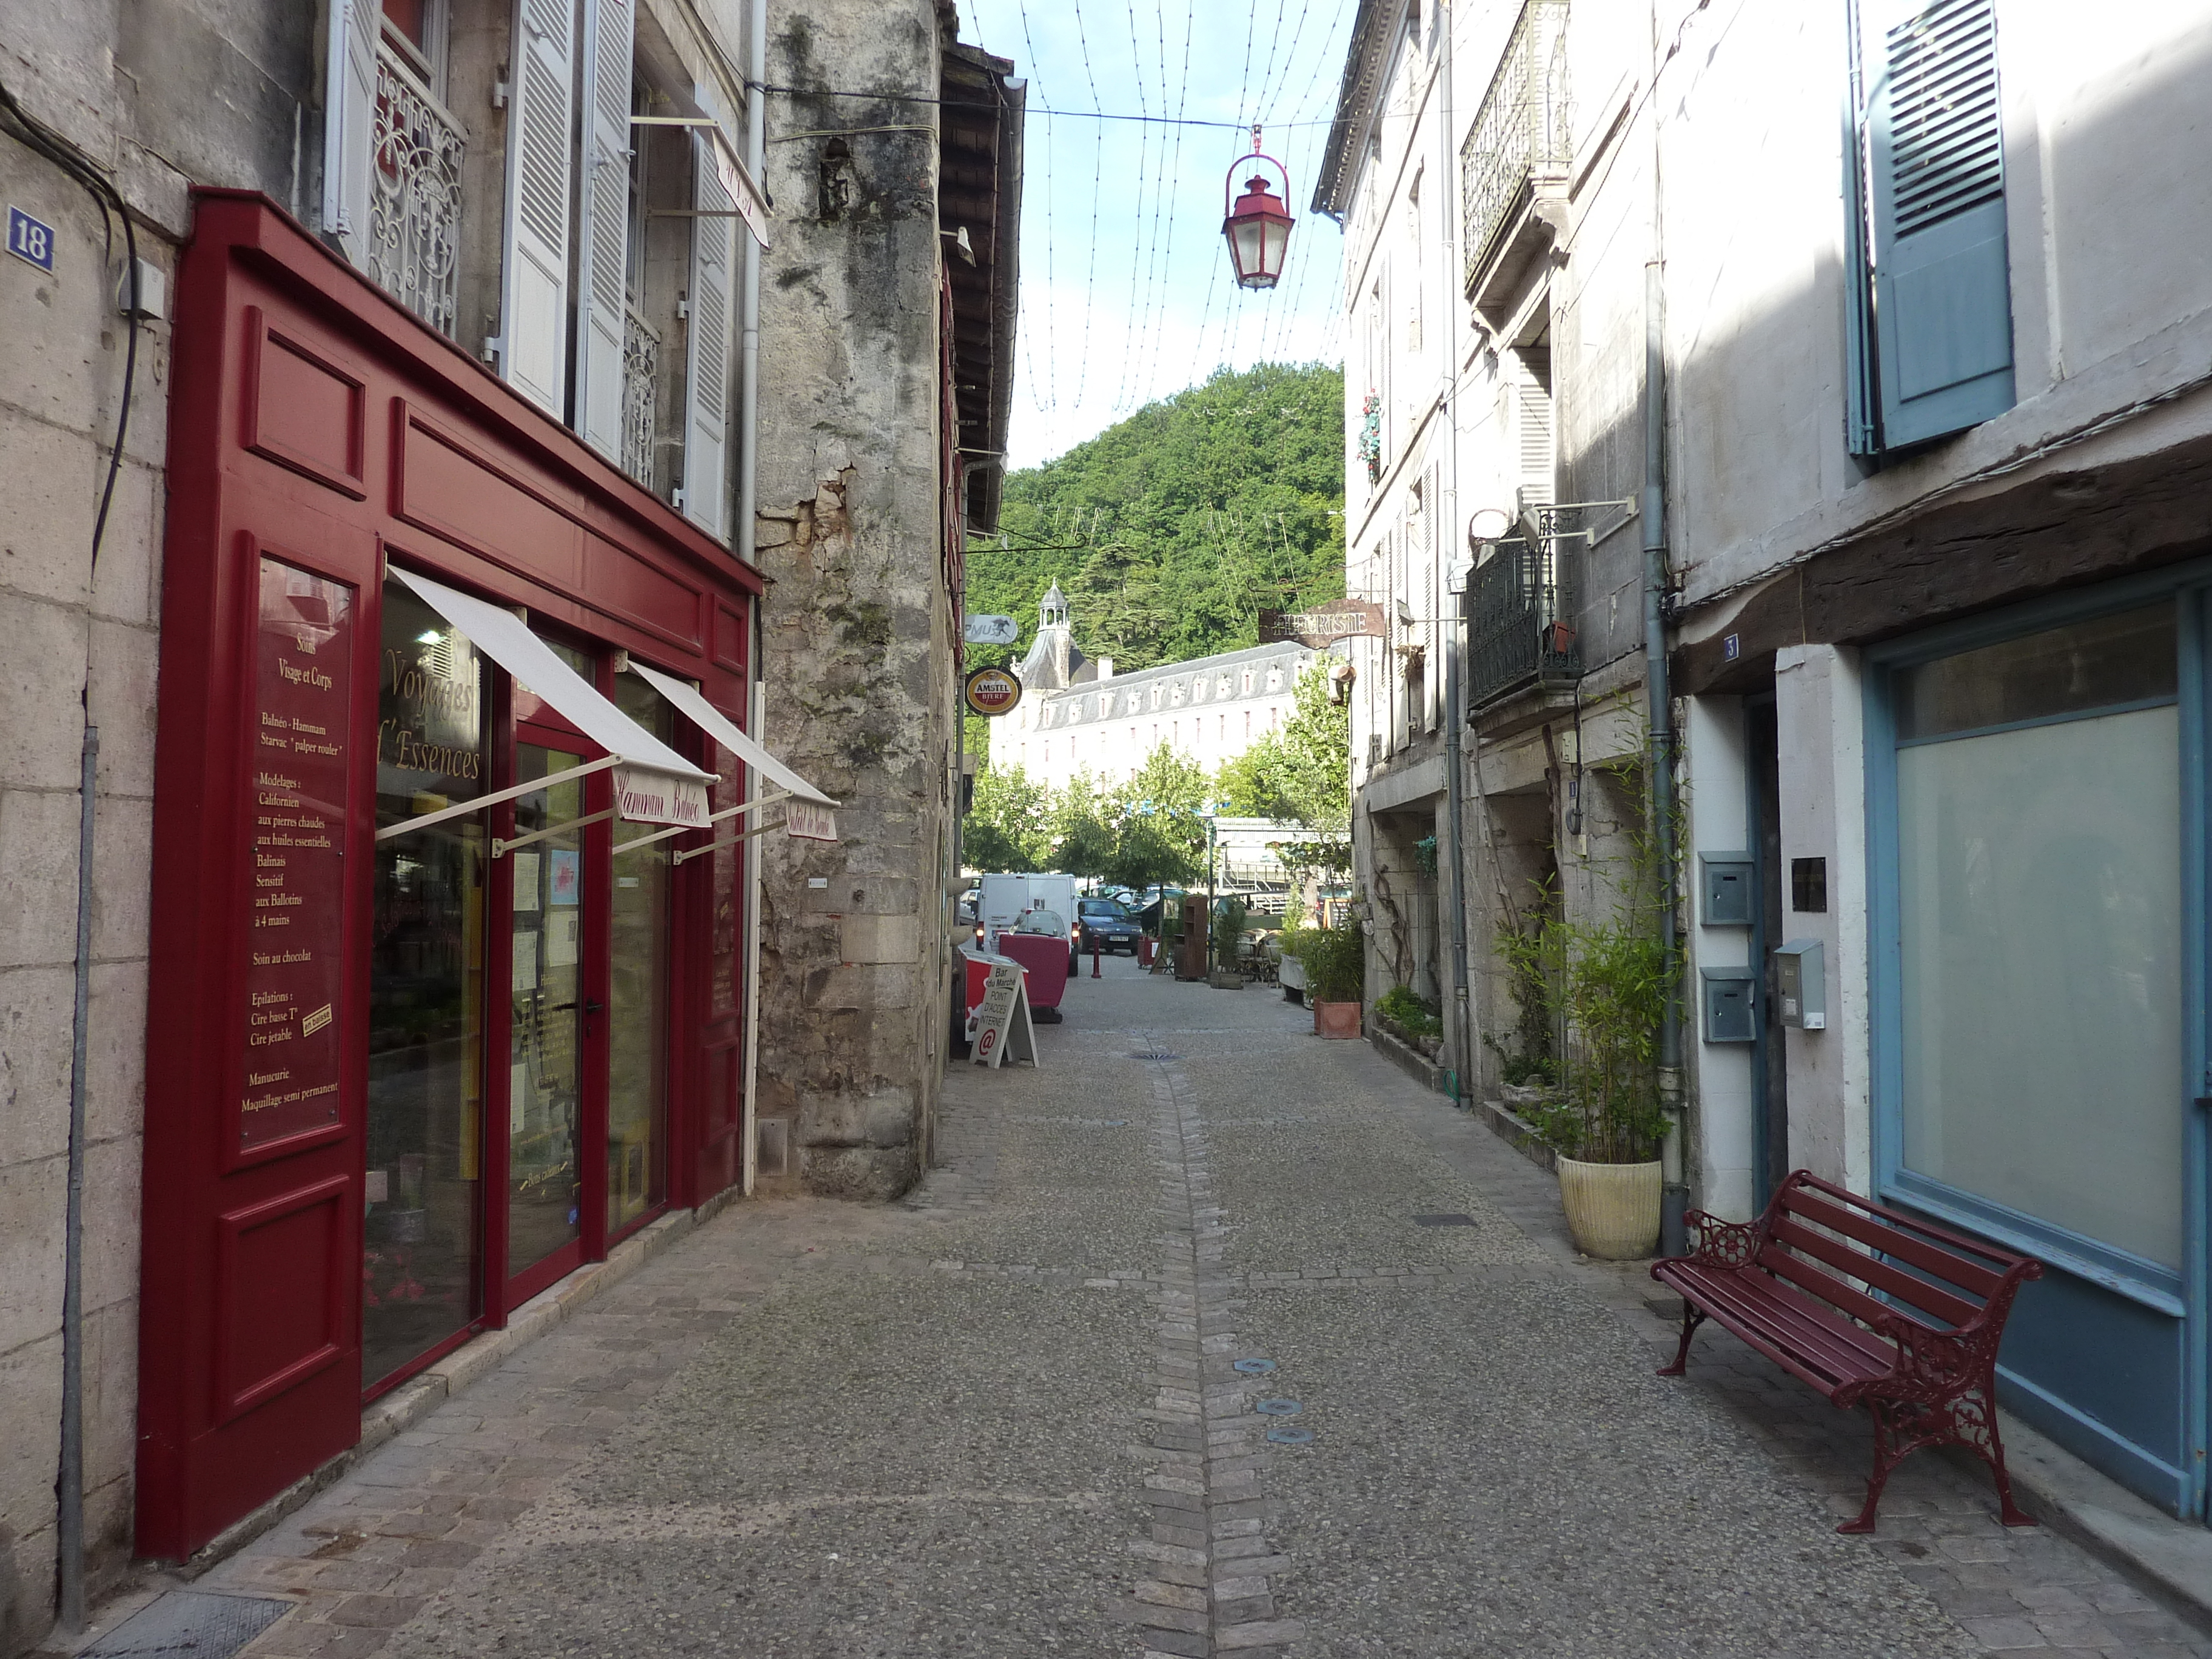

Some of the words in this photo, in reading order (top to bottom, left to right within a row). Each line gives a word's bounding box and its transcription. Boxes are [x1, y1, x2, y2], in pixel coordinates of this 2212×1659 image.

[17, 219, 46, 261] 18
[965, 624, 992, 635] PMU
[1274, 612, 1368, 635] FLEURISTE
[297, 632, 316, 655] Soins
[1728, 639, 1734, 656] 3
[279, 658, 302, 685] Visage
[303, 670, 310, 683] et
[312, 667, 332, 691] Corps
[386, 649, 471, 722] Voyages
[262, 712, 287, 728] Balnéo
[292, 717, 326, 735] Hammam
[261, 732, 287, 748] Starvac
[259, 792, 300, 808] Californien
[258, 816, 272, 825] aux
[273, 814, 297, 828] pierres
[298, 816, 325, 829] chaudes
[257, 836, 270, 845] aux
[272, 833, 293, 846] huiles
[295, 836, 330, 848] essentielles
[257, 854, 286, 867] Balinais
[256, 873, 284, 886] Sensitif
[256, 898, 269, 907] aux
[271, 893, 302, 907] Ballotins
[255, 916, 260, 927] à
[261, 914, 267, 927] 4
[268, 914, 290, 926] mains
[253, 953, 270, 965] Soin
[272, 953, 281, 964] au
[283, 949, 311, 962] chocolat
[995, 968, 1008, 977] Bar
[996, 979, 1016, 987] Marché
[990, 991, 1007, 1002] POINT
[251, 1013, 267, 1025] Cire
[269, 1010, 287, 1023] basse
[312, 1011, 330, 1026] baisse
[980, 1015, 1005, 1027] INTERNET
[250, 1033, 267, 1045] Cire
[268, 1027, 292, 1045] jetable
[249, 1067, 289, 1087] Manucurie
[242, 1093, 282, 1112] Maquillage
[284, 1088, 300, 1102] semi
[301, 1082, 338, 1101] permanent
